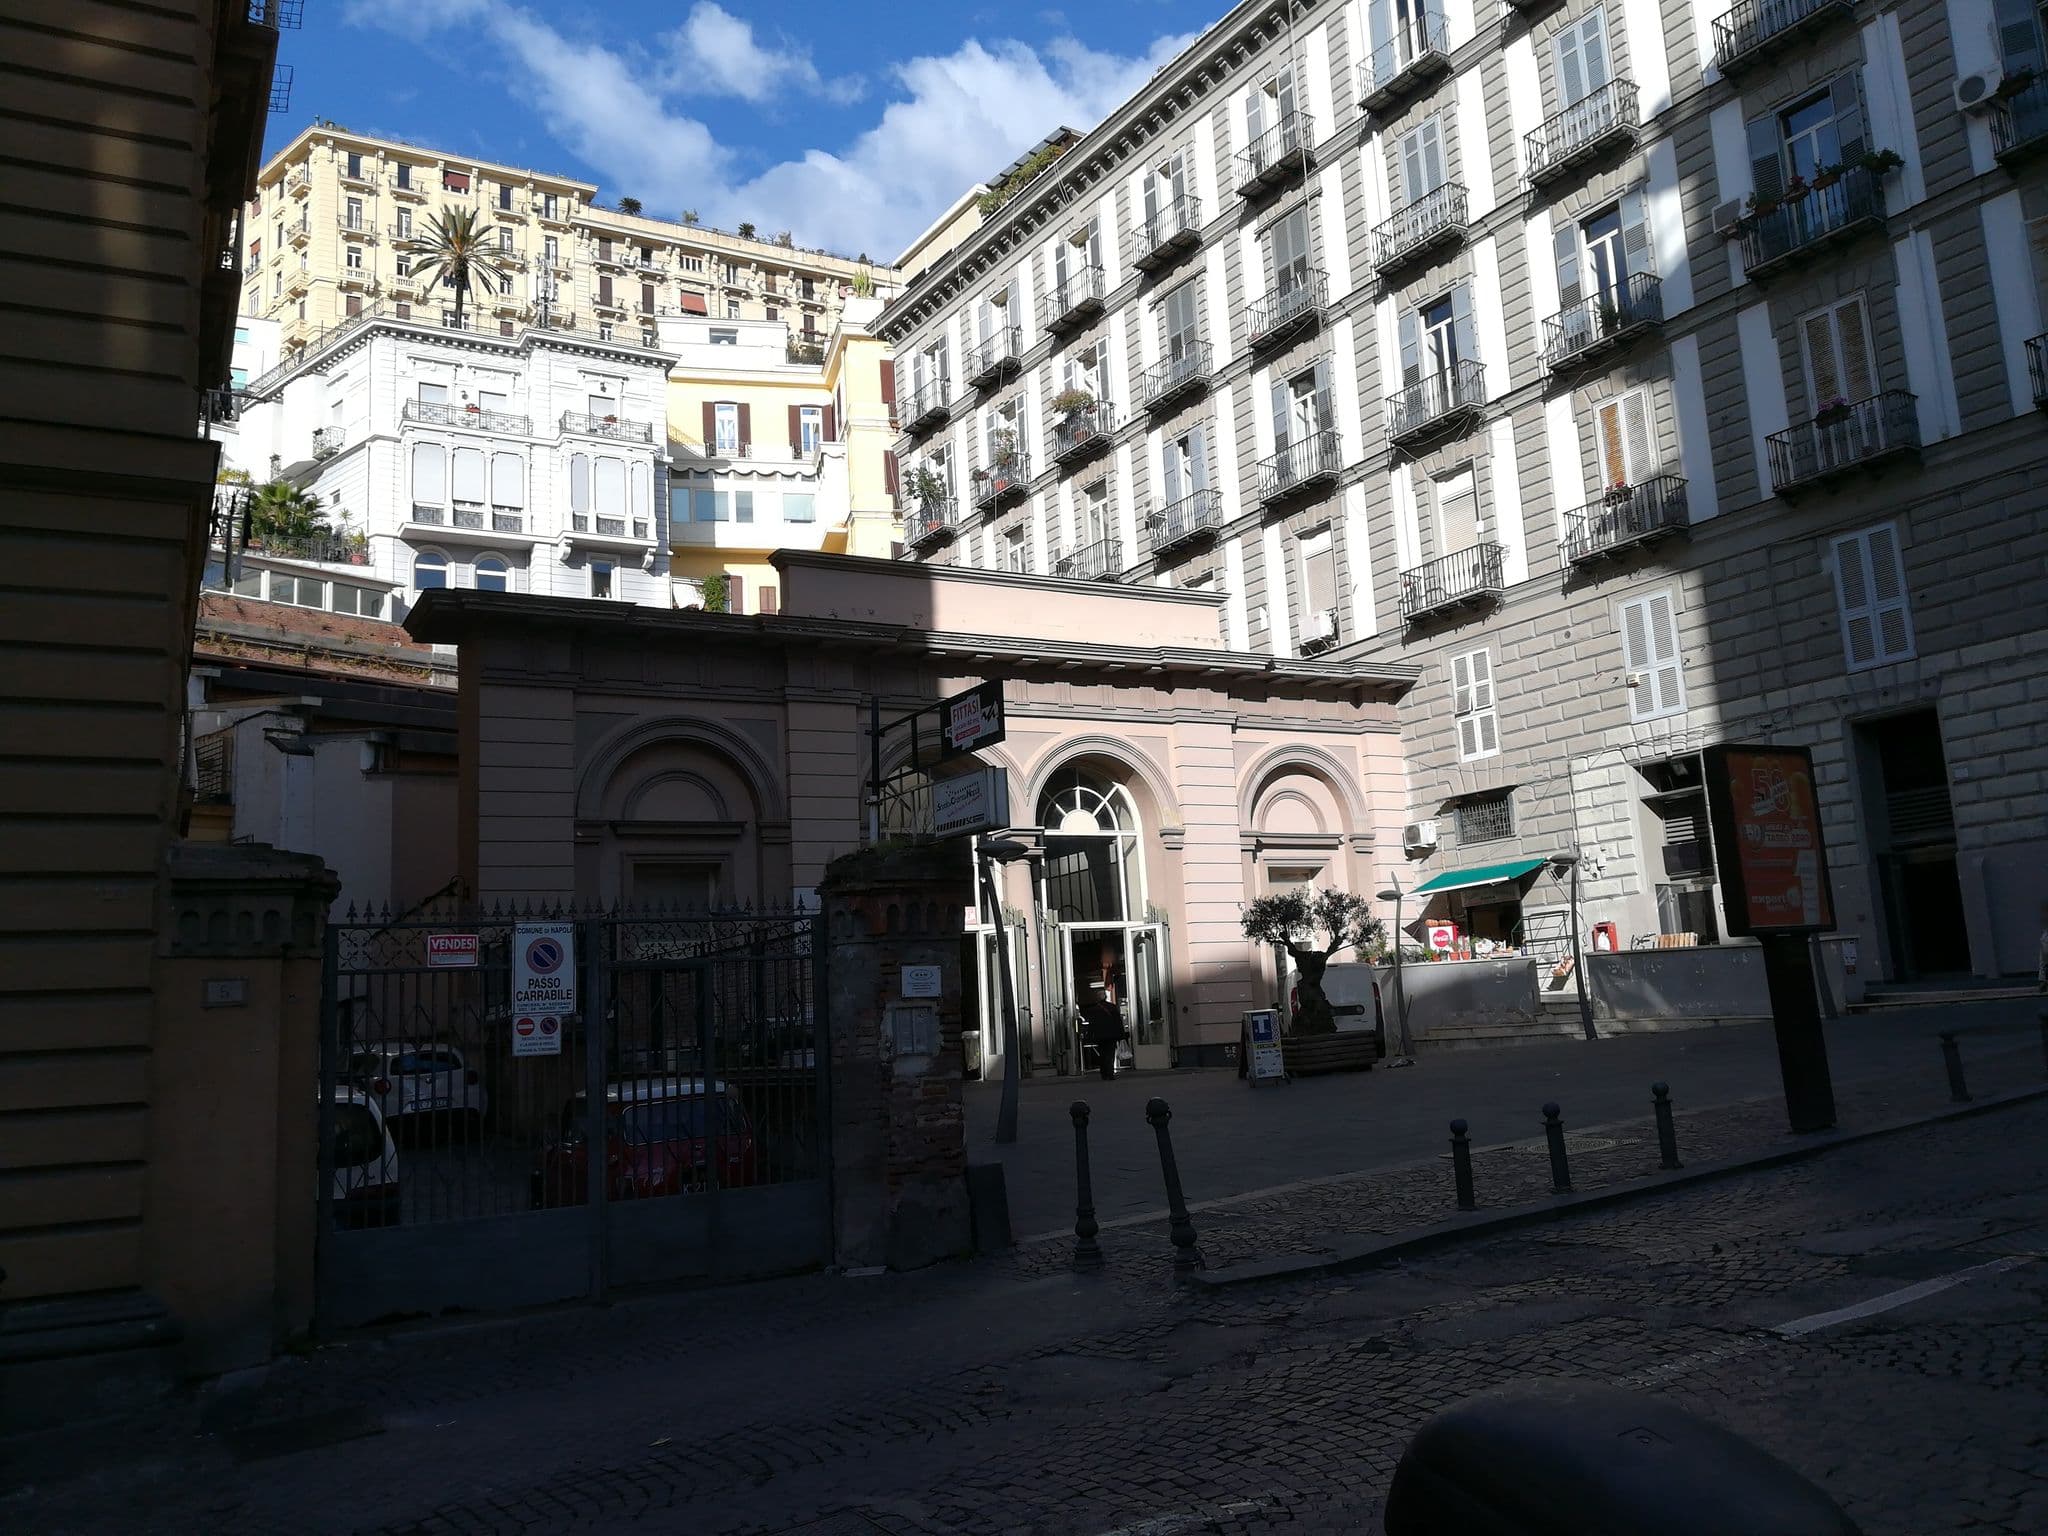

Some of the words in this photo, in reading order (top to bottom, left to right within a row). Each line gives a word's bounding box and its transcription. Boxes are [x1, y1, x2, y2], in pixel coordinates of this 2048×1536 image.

[953, 698, 979, 723] FITTASI
[431, 938, 475, 950] VENDESI
[528, 977, 561, 989] PASSO
[516, 989, 572, 1002] CARRABILE
